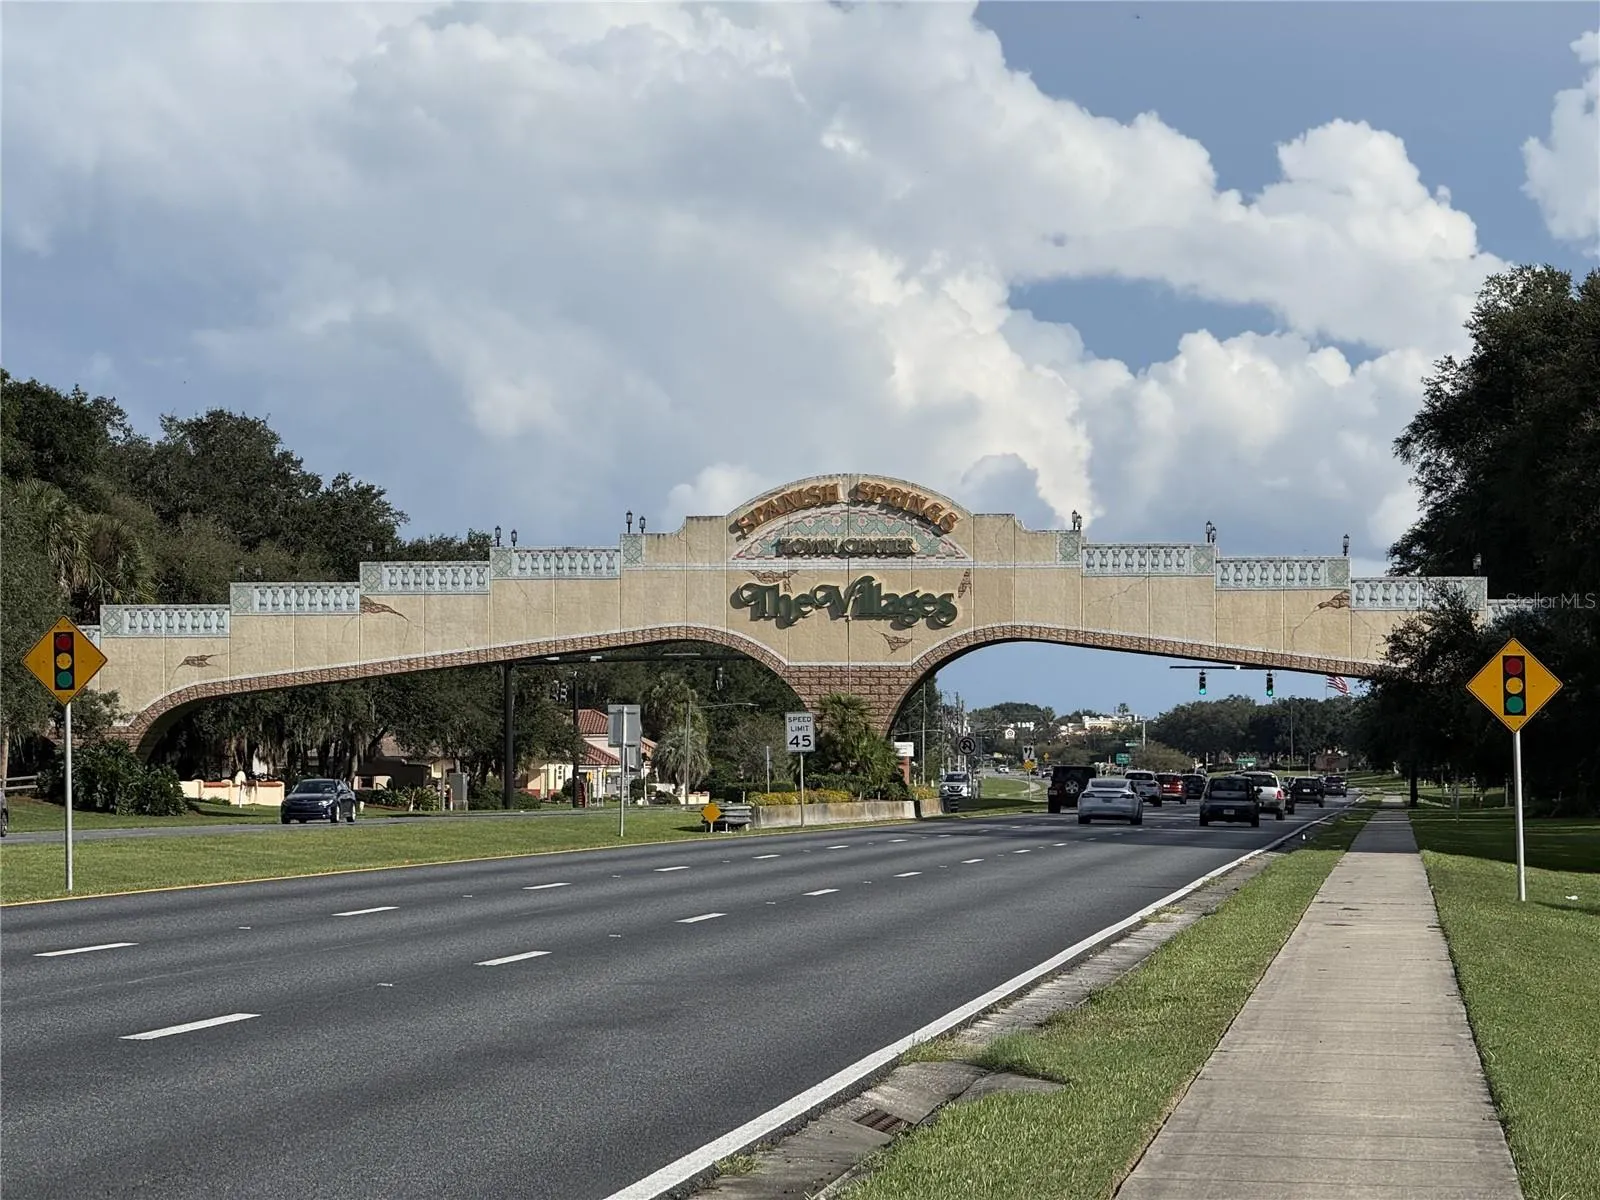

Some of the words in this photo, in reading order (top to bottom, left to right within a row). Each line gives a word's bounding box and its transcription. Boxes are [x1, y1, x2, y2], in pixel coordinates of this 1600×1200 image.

[736, 483, 840, 537] SPANISH
[857, 481, 959, 534] SPRINGS
[779, 537, 838, 555] TOWN
[841, 537, 918, 555] CENTER
[738, 582, 814, 623] The
[813, 575, 958, 626] Villages
[789, 735, 811, 747] 45
